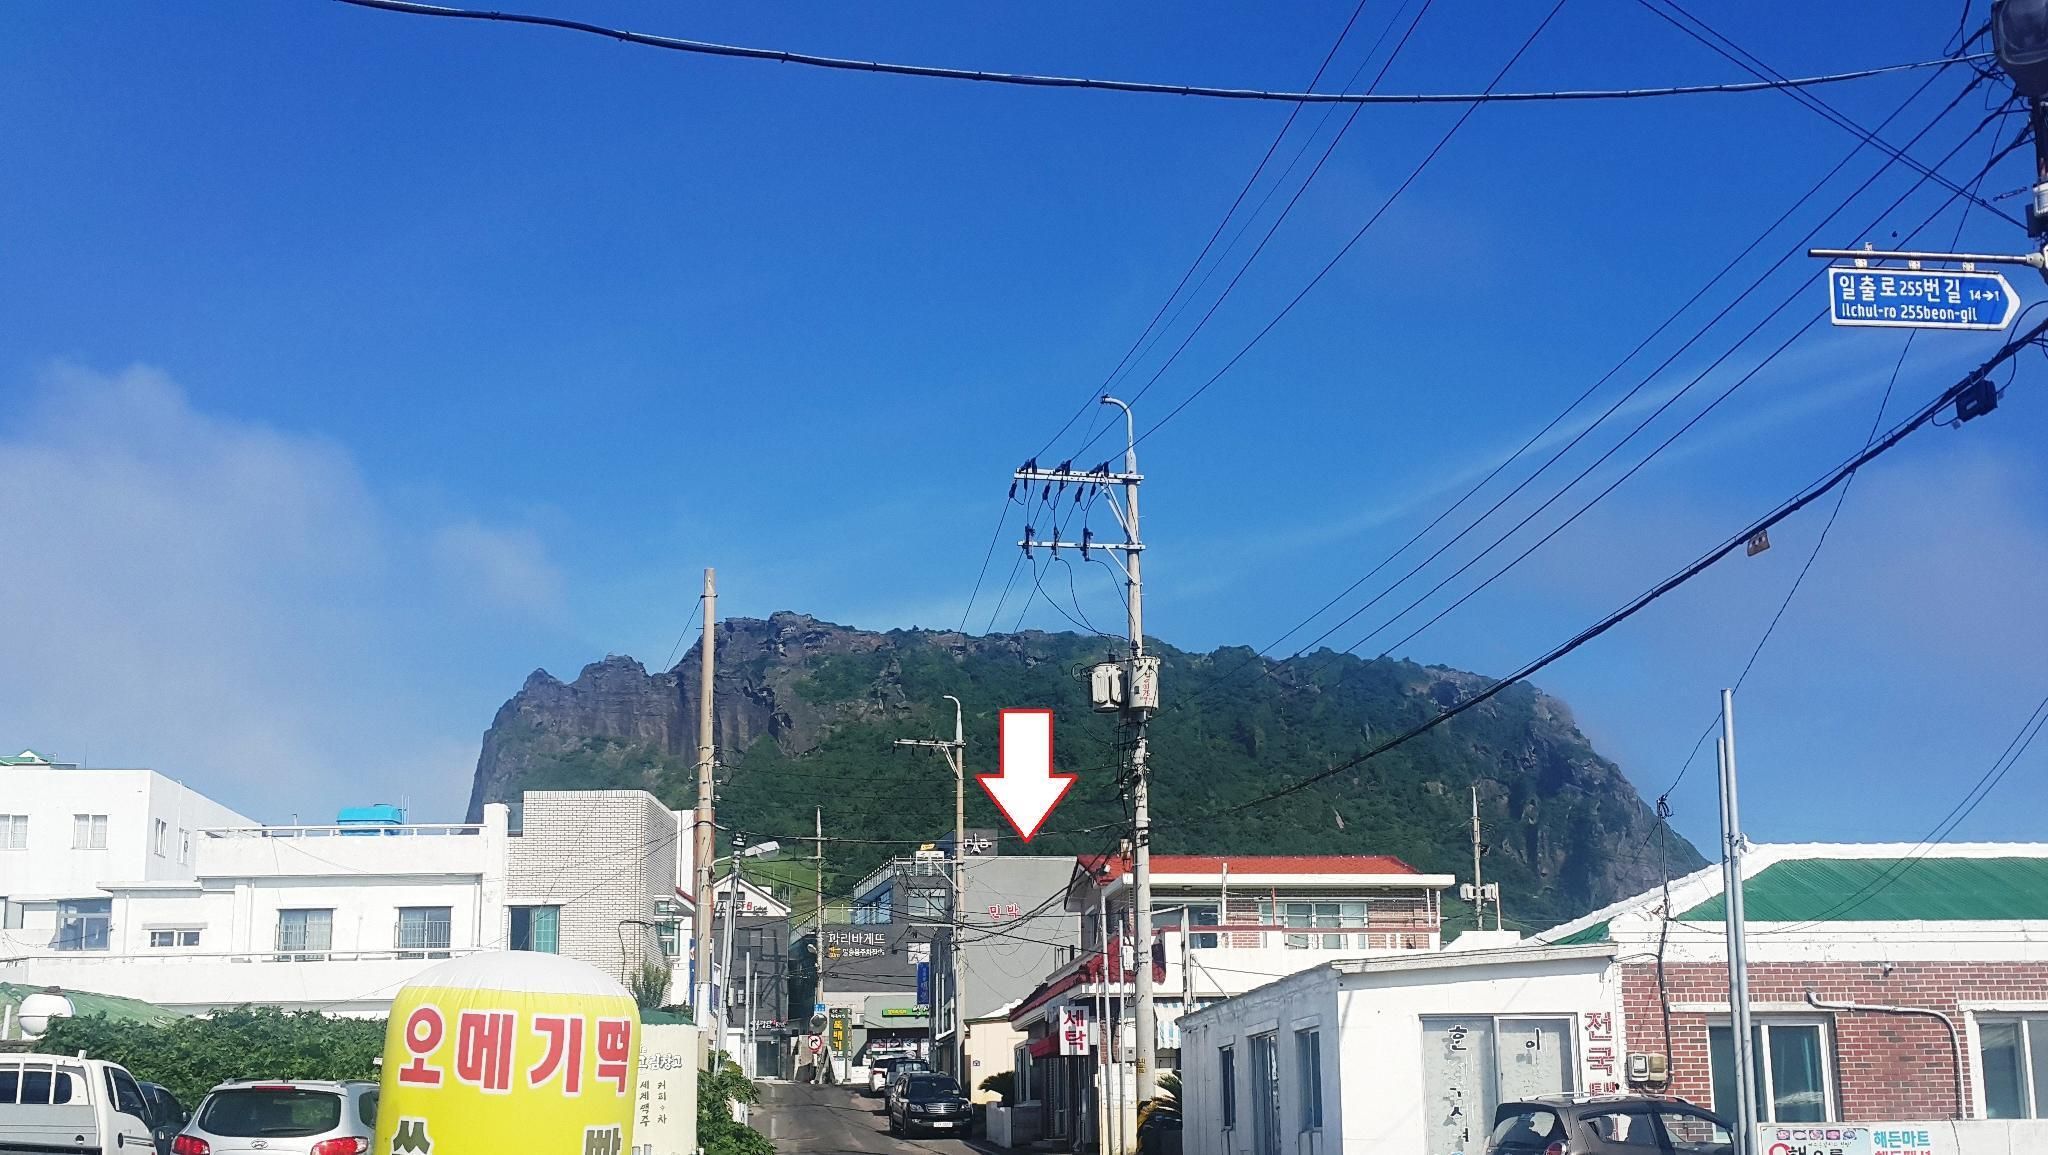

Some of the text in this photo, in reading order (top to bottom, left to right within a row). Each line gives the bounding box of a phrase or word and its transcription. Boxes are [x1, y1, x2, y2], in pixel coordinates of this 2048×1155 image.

[1900, 304, 1978, 323] 255beon-gil
[988, 902, 1020, 920] 민박
[828, 931, 886, 946] 파리바게뜨
[1063, 1009, 1087, 1051] 세탁
[398, 1005, 632, 1093] 오메기떡
[1873, 1130, 1931, 1149] 해든마트
